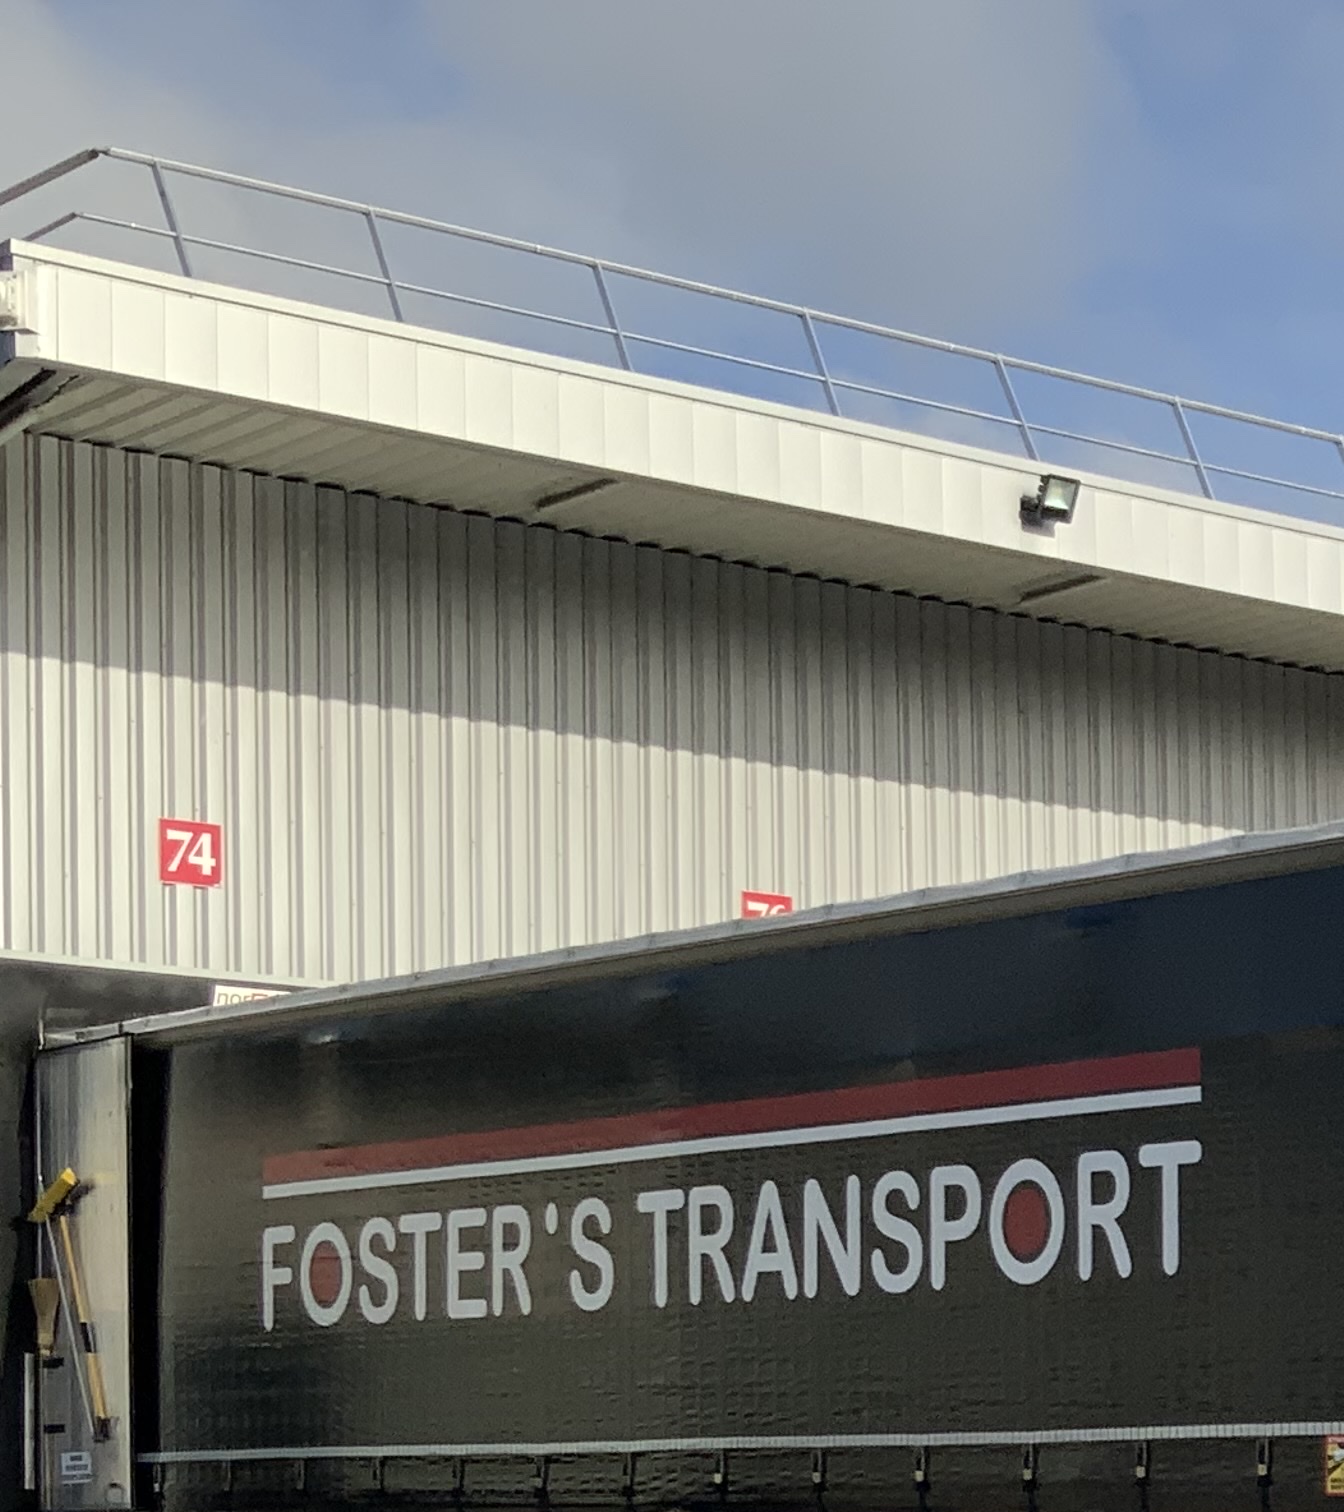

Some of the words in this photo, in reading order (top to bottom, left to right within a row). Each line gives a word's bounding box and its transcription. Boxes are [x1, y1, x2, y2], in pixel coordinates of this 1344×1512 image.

[166, 828, 217, 876] 74
[263, 1197, 615, 1332] FOSTER'S
[637, 1139, 1202, 1308] TRANSPORT
